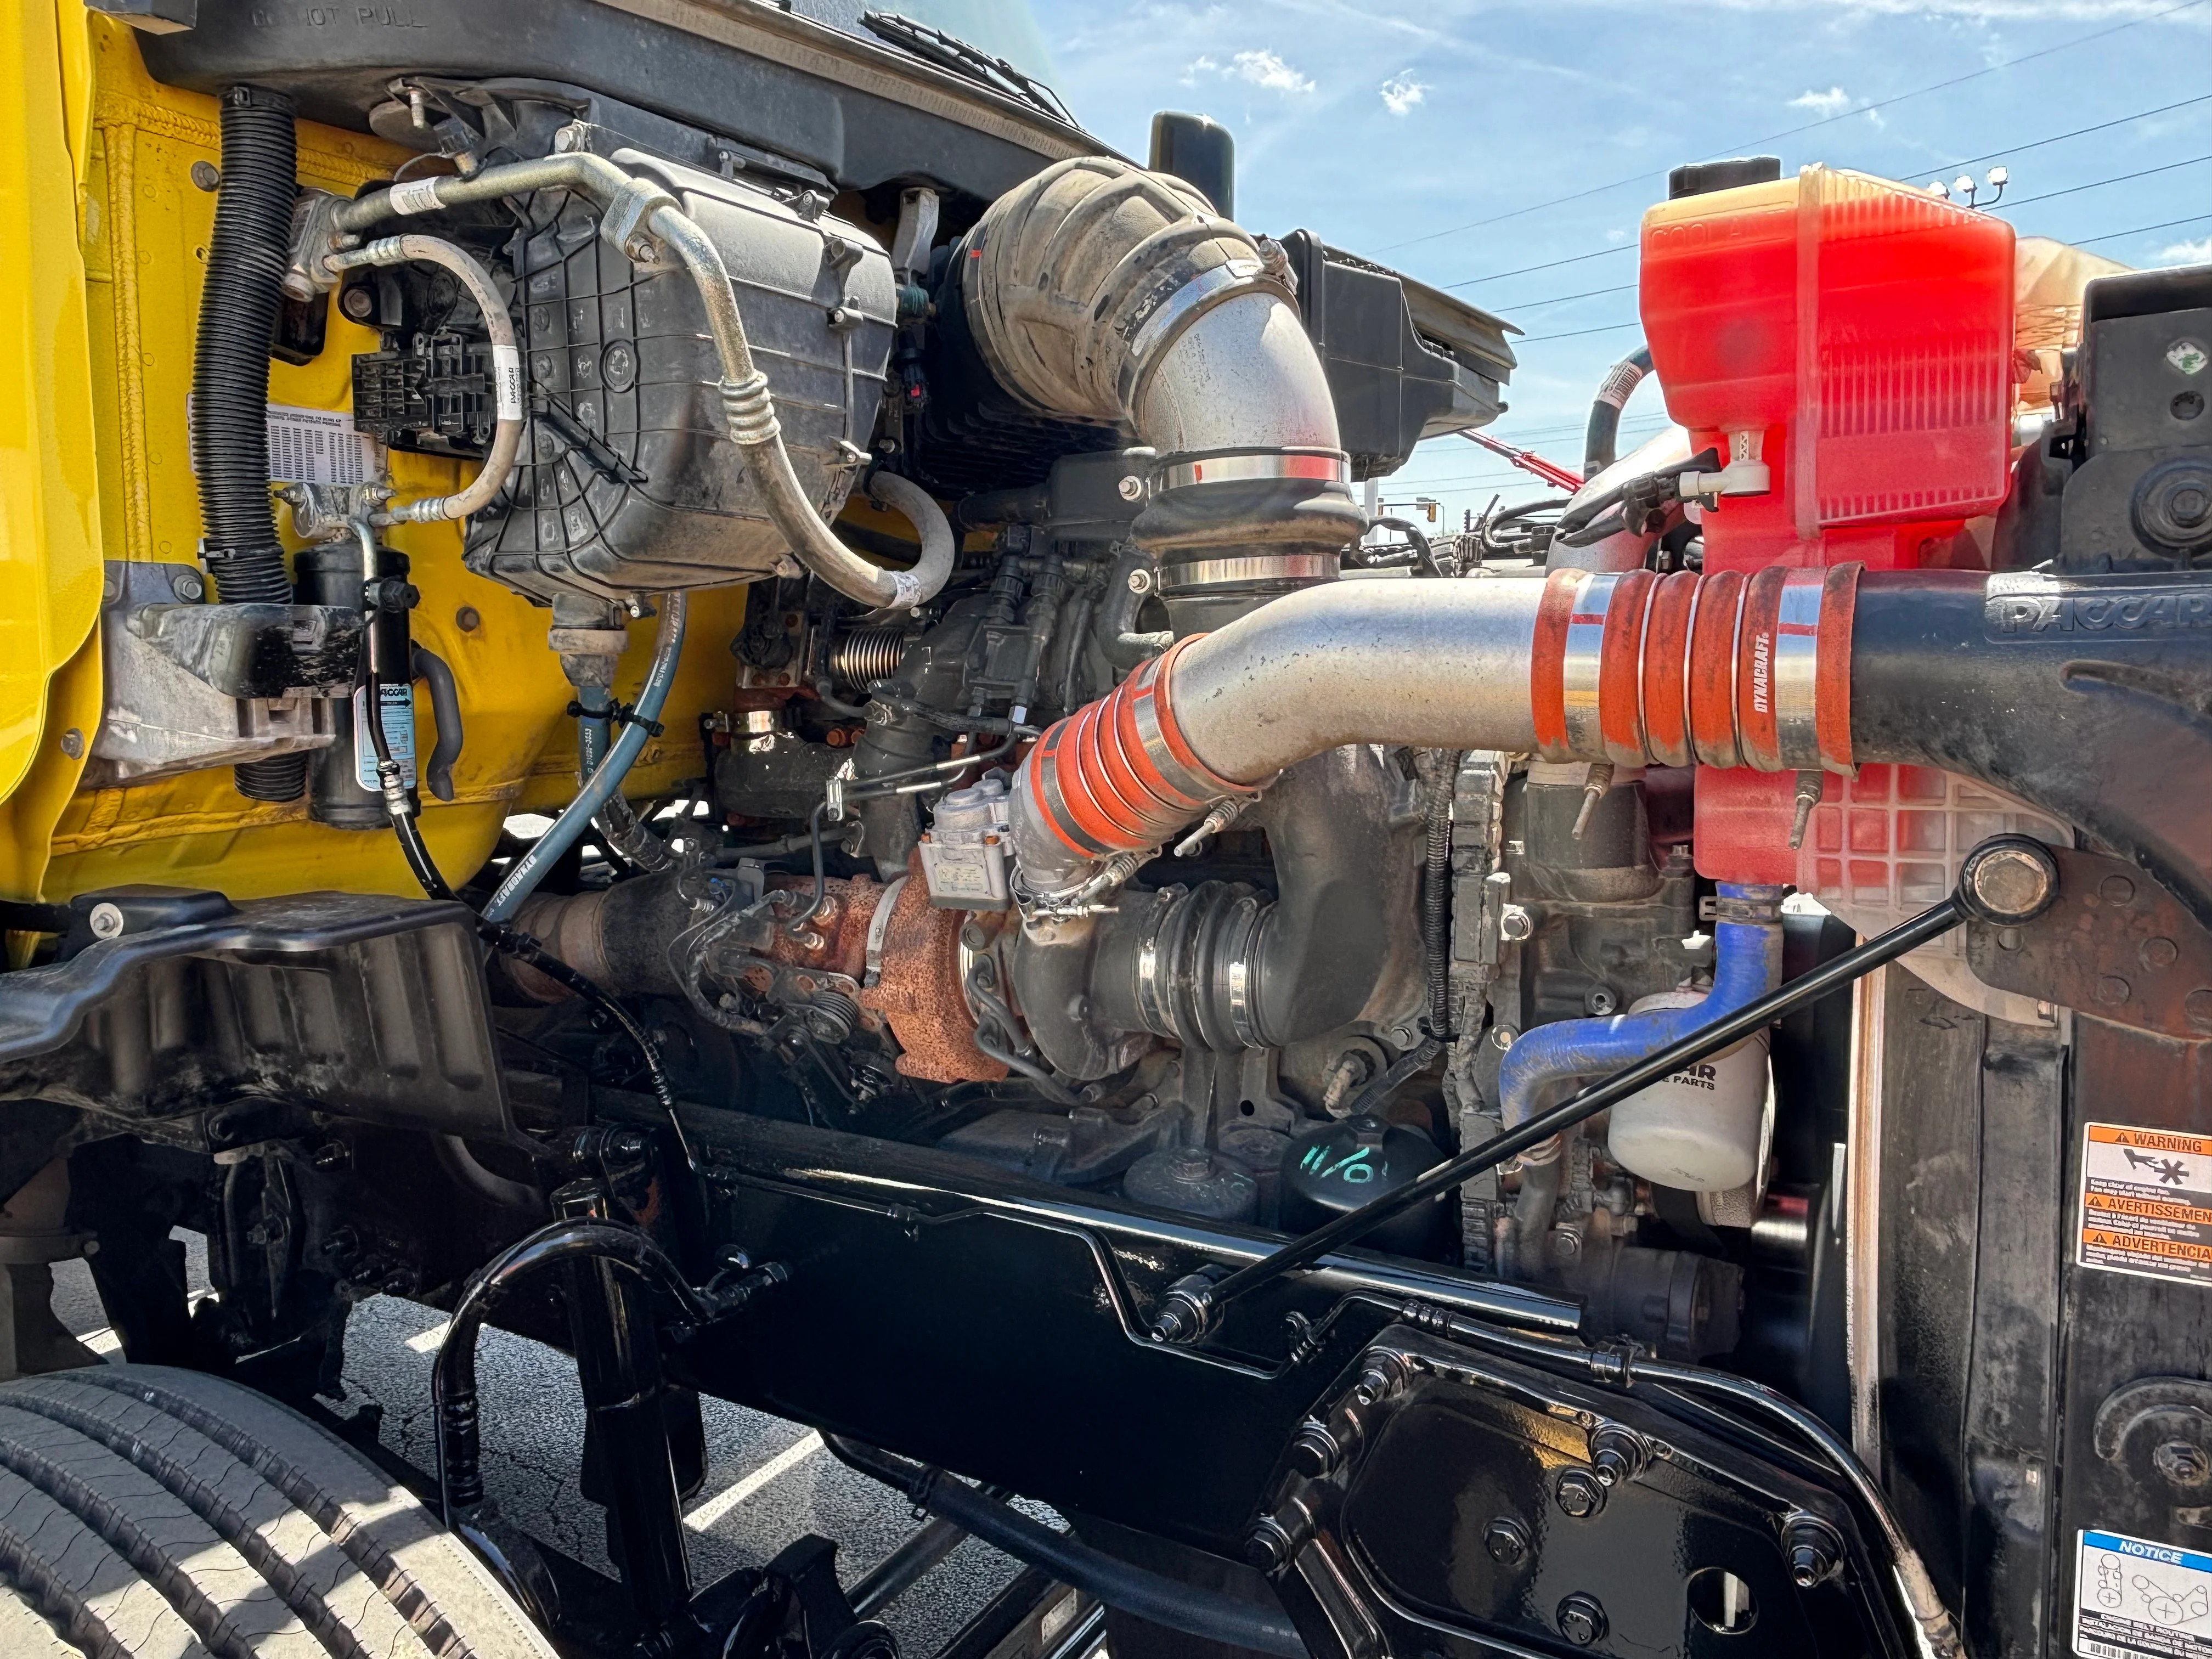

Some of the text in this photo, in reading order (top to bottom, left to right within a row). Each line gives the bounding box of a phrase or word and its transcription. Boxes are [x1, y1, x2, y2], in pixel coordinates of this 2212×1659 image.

[358, 7, 428, 27] PULL
[2001, 594, 2212, 633] PACCAR
[1753, 633, 1769, 713] DYNACRAFT
[1673, 1076, 1715, 1090] PARTS
[2134, 1133, 2202, 1153] WARNING
[2112, 1235, 2211, 1260] ADVERTENCIA
[2119, 1541, 2184, 1565] NOTICE
